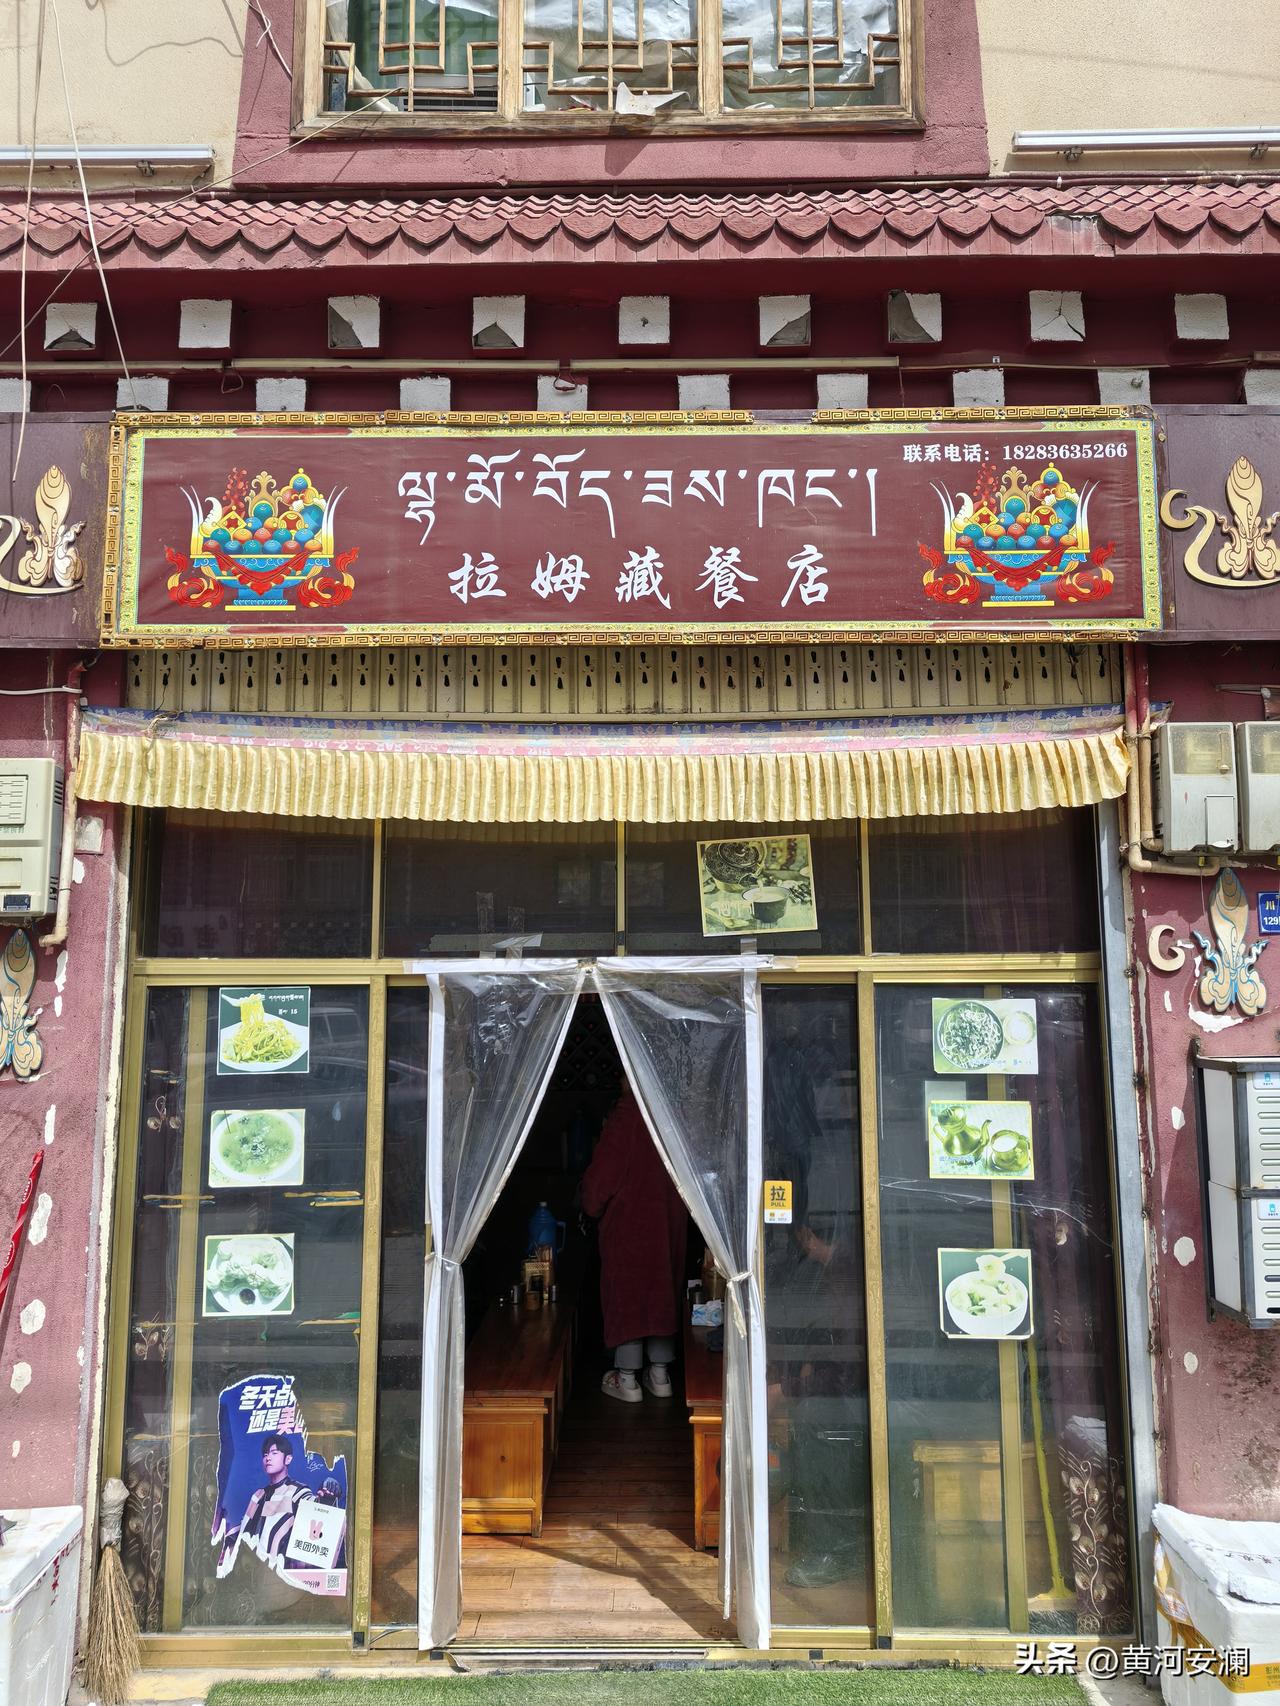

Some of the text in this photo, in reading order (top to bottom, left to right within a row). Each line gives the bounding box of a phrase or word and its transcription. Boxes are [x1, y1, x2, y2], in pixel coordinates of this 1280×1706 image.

[1002, 442, 1129, 460] 18283635266
[448, 544, 831, 610] 拉姆藏餐店
[770, 1185, 786, 1201] 拉
[239, 1384, 298, 1411] 冬天点
[293, 1539, 330, 1557] 美团外卖
